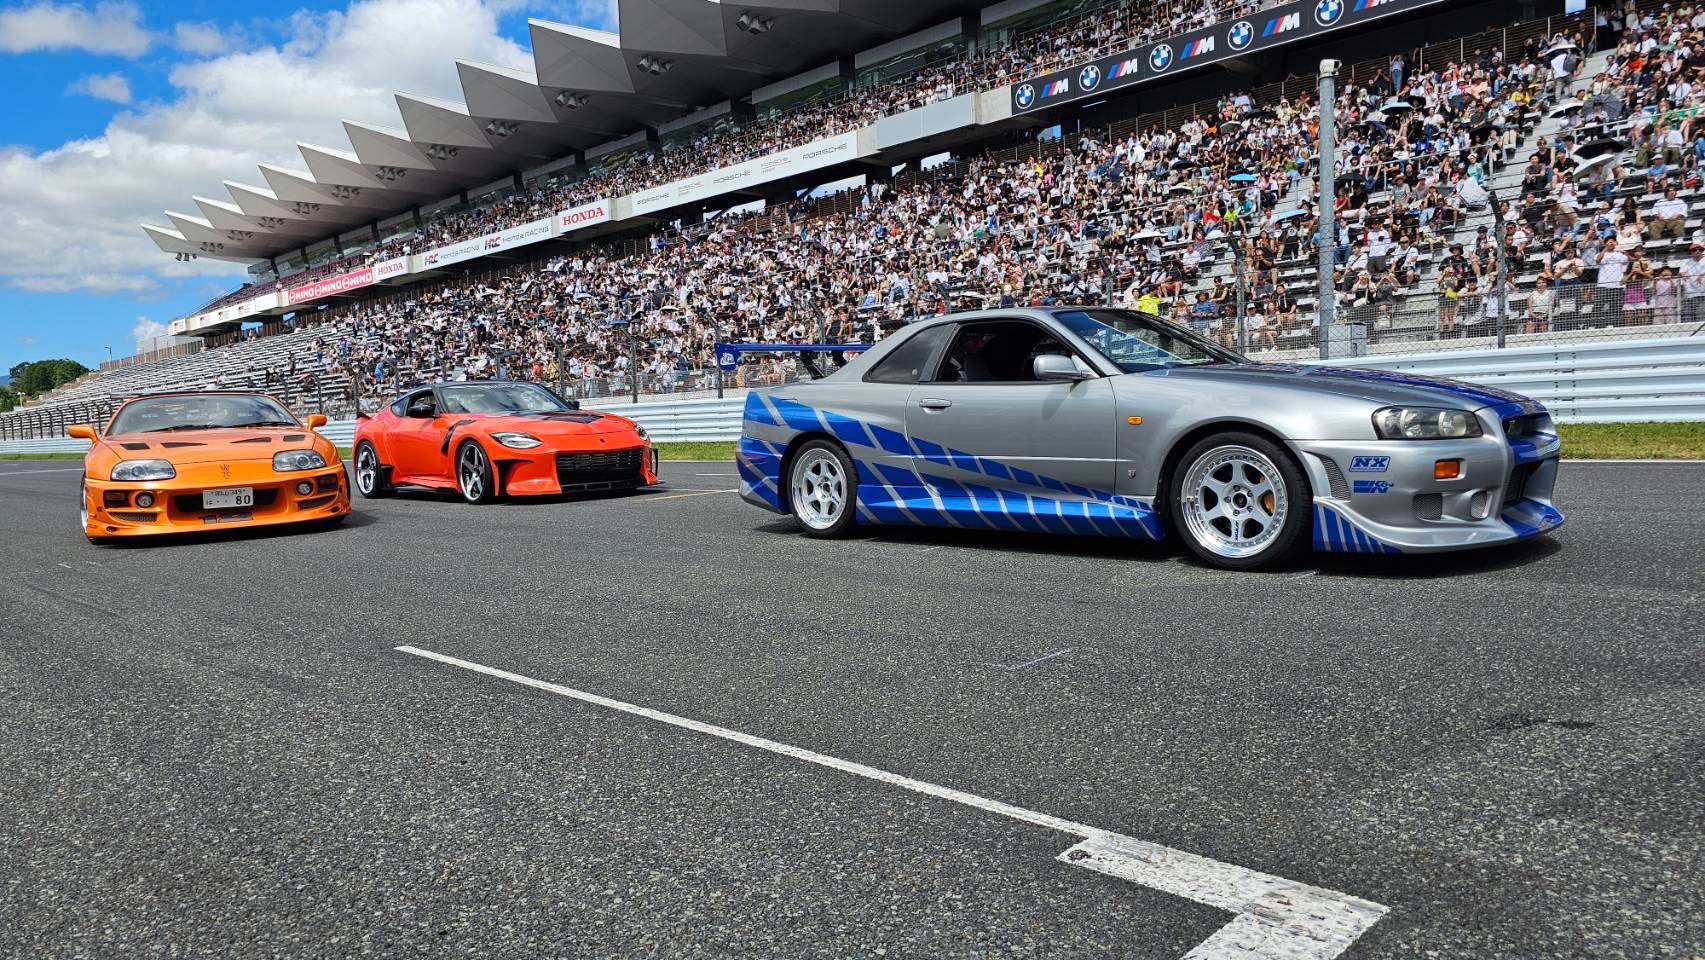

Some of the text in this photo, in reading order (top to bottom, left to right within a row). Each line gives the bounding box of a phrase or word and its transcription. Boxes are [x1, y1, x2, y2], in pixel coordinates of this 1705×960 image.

[802, 143, 848, 160] PORSCHE
[712, 170, 752, 184] PORSCHE
[637, 193, 670, 205] PORSCHE
[562, 207, 605, 226] HONDA
[378, 262, 404, 276] HONDA
[295, 272, 373, 300] HINO HINO HINO
[1353, 457, 1388, 467] NX
